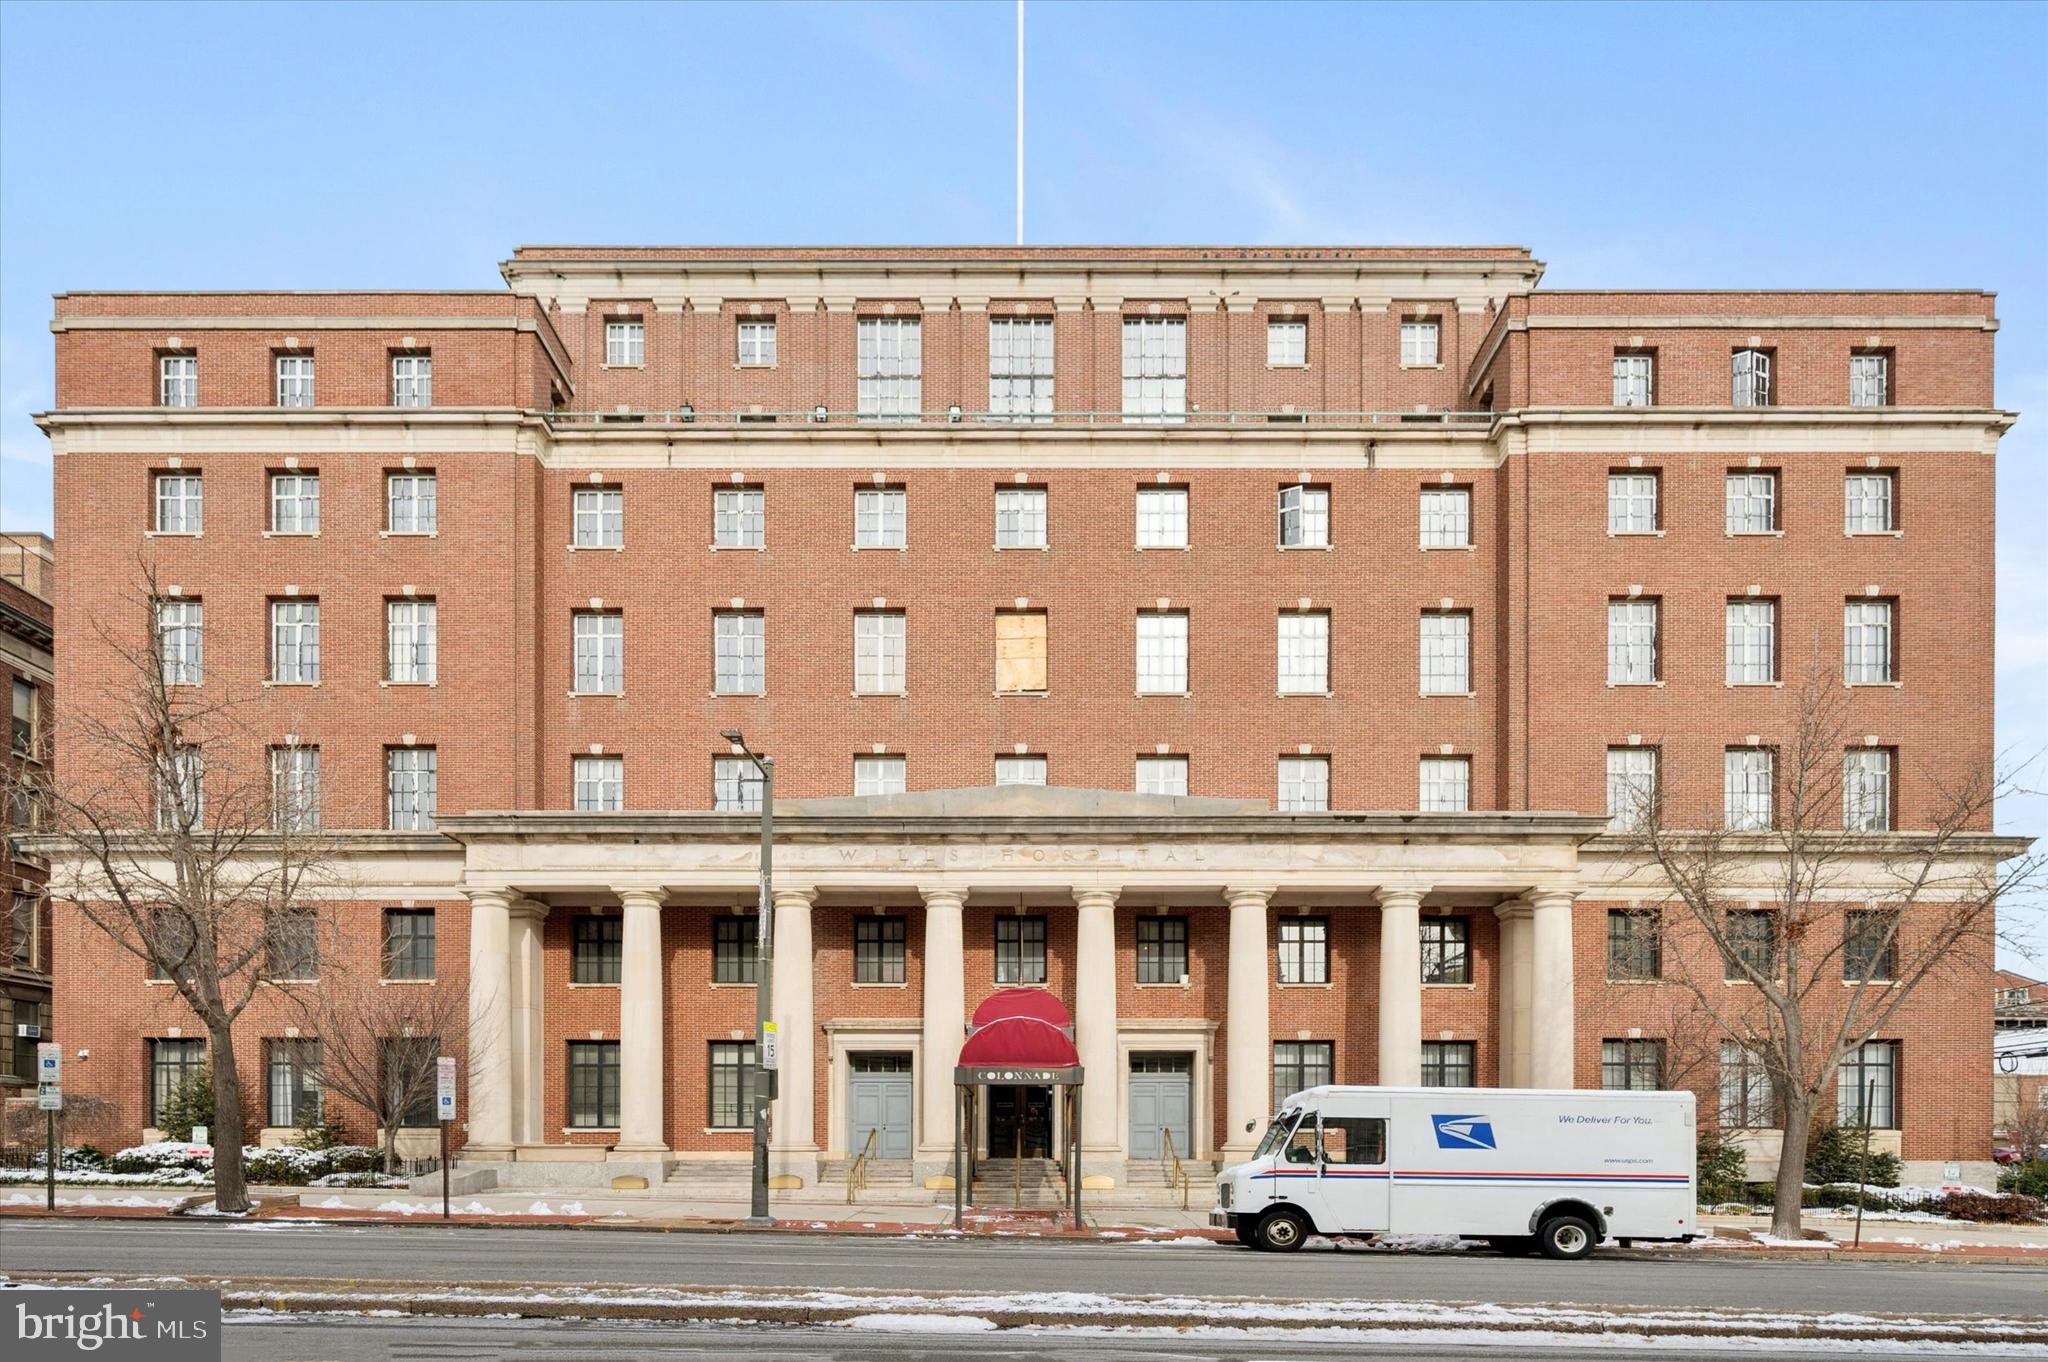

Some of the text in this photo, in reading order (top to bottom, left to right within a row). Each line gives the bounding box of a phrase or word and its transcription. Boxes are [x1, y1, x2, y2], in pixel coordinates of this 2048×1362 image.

[838, 848, 1206, 862] WILLS HOSPITAL
[766, 1044, 775, 1058] 15
[977, 1071, 1060, 1080] COLONNADE
[1558, 1115, 1575, 1124] We
[1576, 1115, 1612, 1124] Deliver
[1614, 1115, 1631, 1124] For
